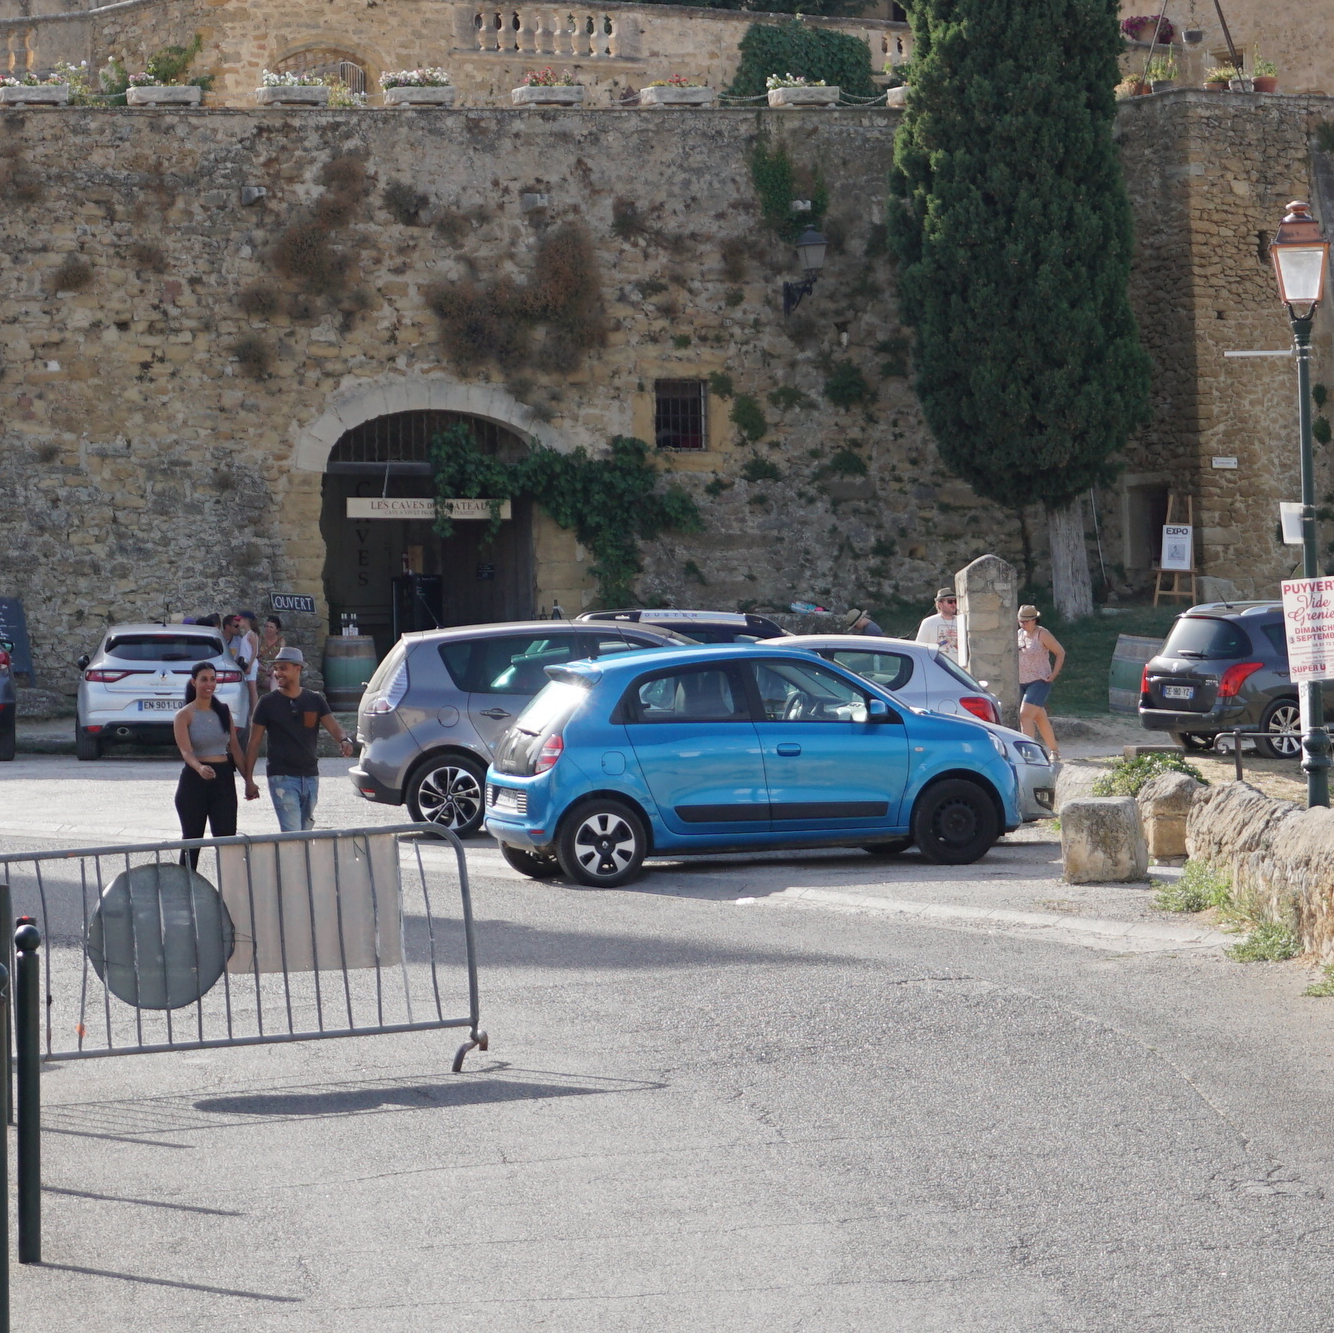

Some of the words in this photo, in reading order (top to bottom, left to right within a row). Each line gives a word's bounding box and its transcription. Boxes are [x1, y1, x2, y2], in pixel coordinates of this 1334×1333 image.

[370, 500, 389, 510] LES
[391, 500, 425, 510] CAVES
[356, 481, 371, 586] CVES
[1166, 527, 1189, 535] EXPO
[274, 595, 313, 611] OUVERT
[1297, 594, 1331, 610] Vide
[1292, 665, 1319, 673] SUPER
[1320, 663, 1327, 671] U
